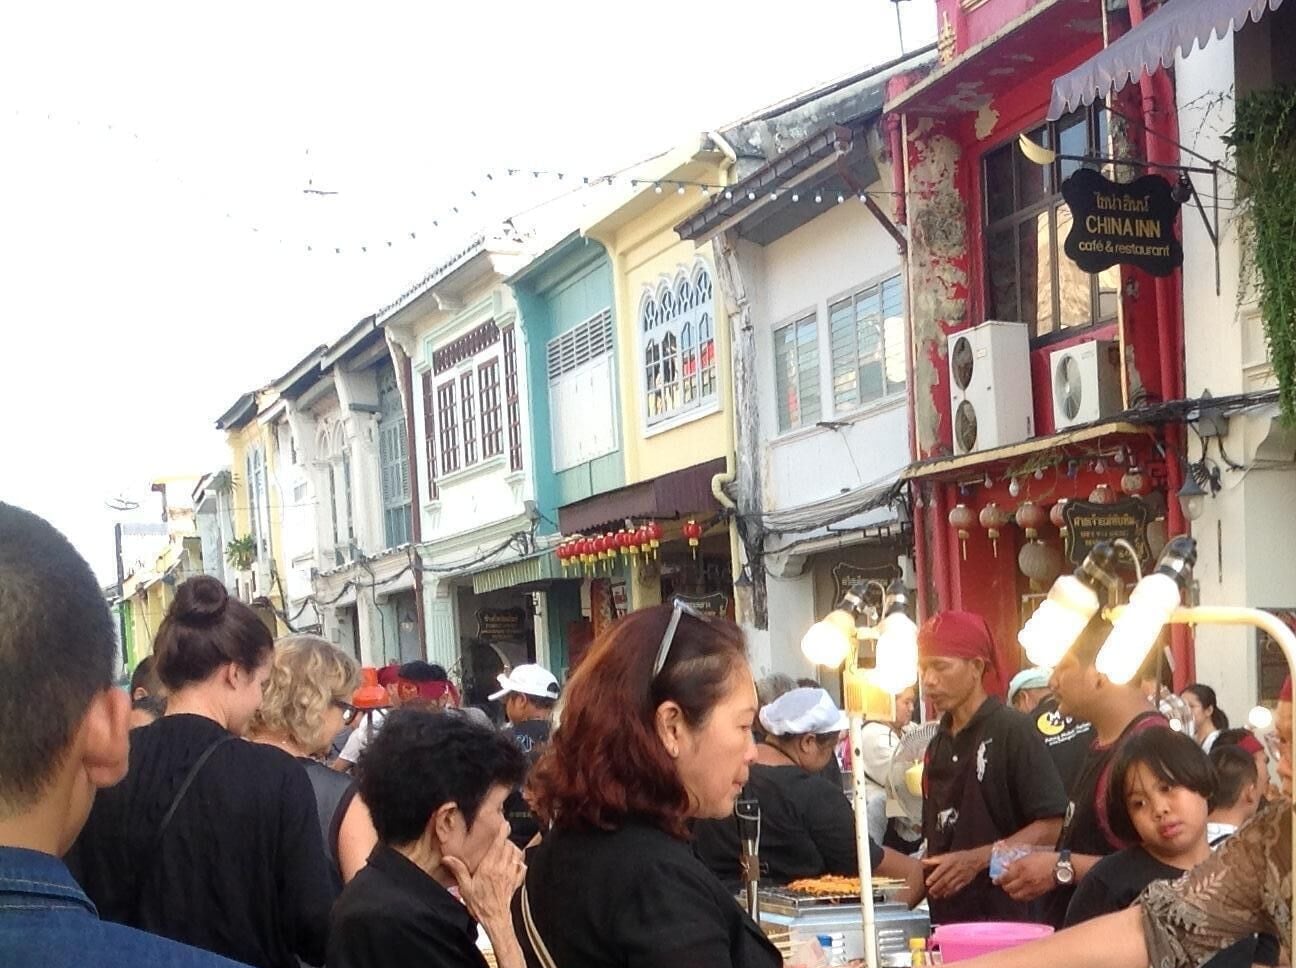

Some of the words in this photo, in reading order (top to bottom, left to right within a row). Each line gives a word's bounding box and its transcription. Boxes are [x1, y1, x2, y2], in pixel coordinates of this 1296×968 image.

[1085, 214, 1134, 236] CHINA
[1135, 218, 1161, 238] INN
[1078, 239, 1104, 252] café
[1105, 240, 1114, 253] &
[1115, 243, 1170, 257] restaurant
